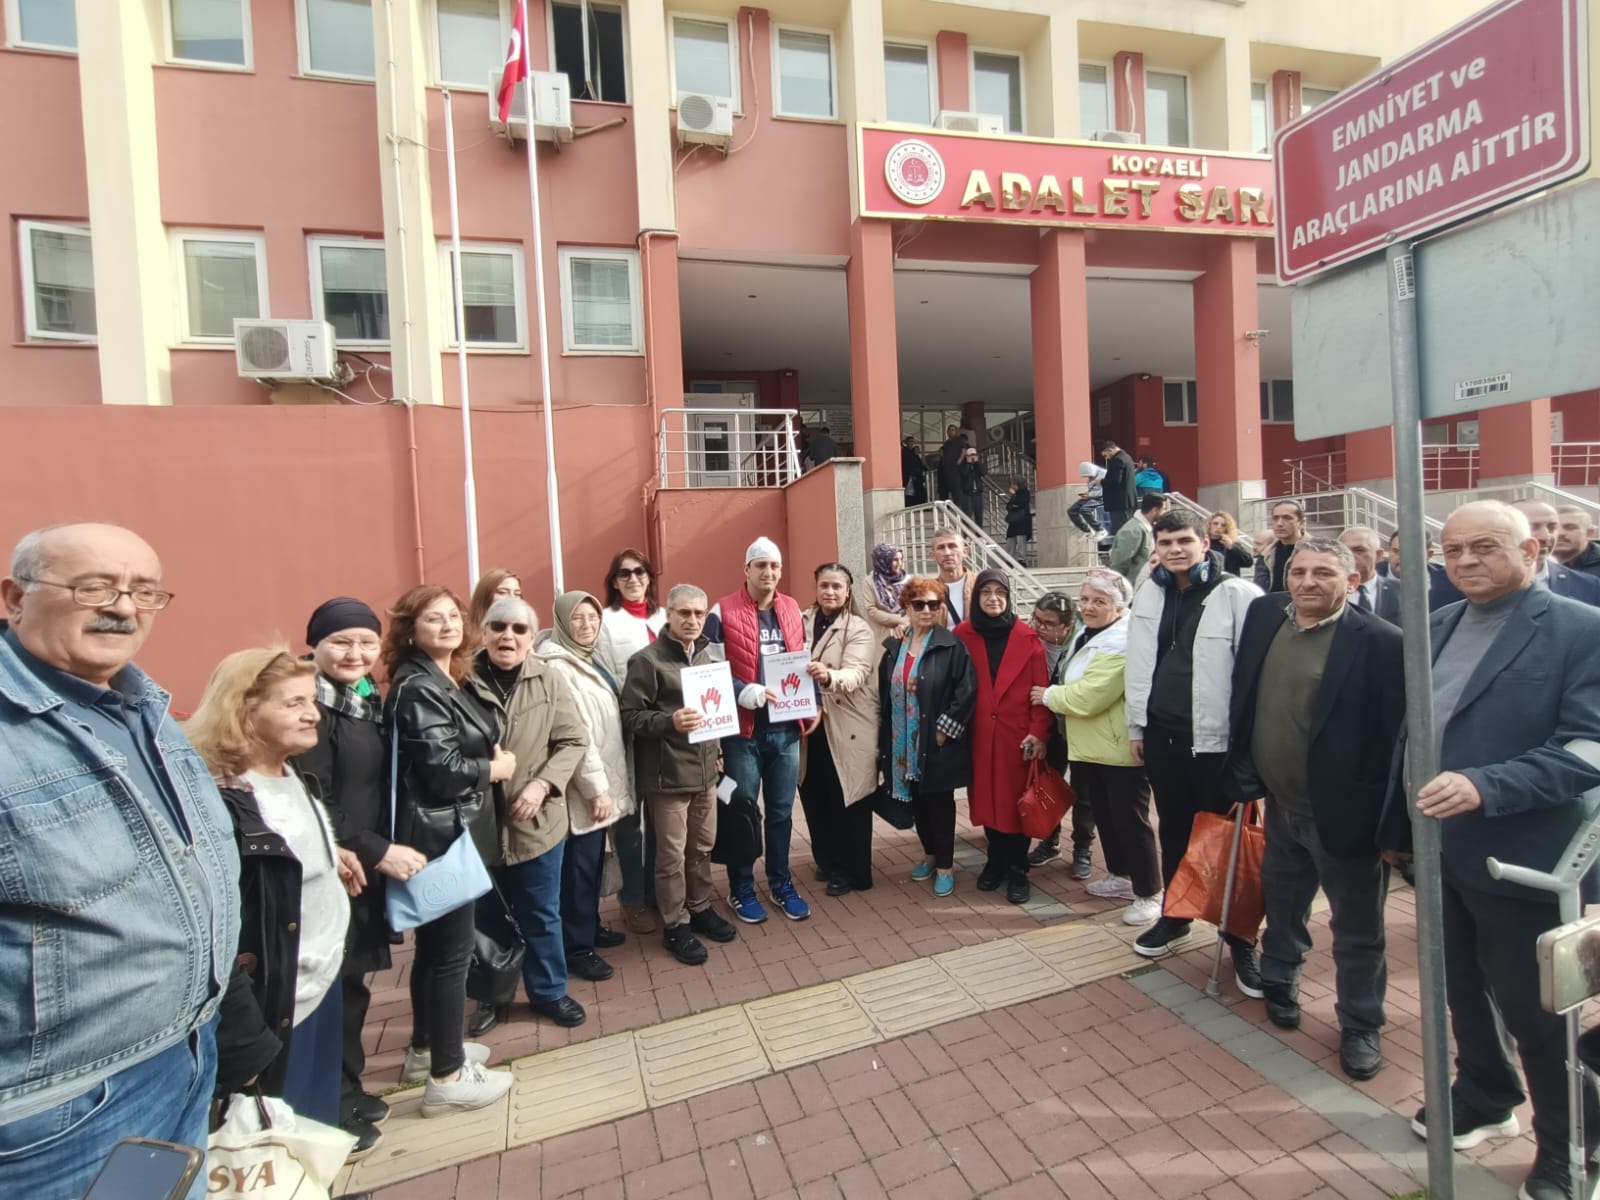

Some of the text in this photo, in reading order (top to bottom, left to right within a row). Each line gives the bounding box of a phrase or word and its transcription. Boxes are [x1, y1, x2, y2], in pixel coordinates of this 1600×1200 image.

[1332, 56, 1486, 152] EMNİYET ve
[1292, 112, 1556, 250] ARAÇLARINA AİTTİR
[1335, 99, 1483, 191] JANDARMA
[959, 169, 1161, 218] ADALET
[1177, 182, 1274, 225] SAR
[700, 714, 733, 728] OÇ-DER
[774, 697, 811, 711] KOÇ-DER
